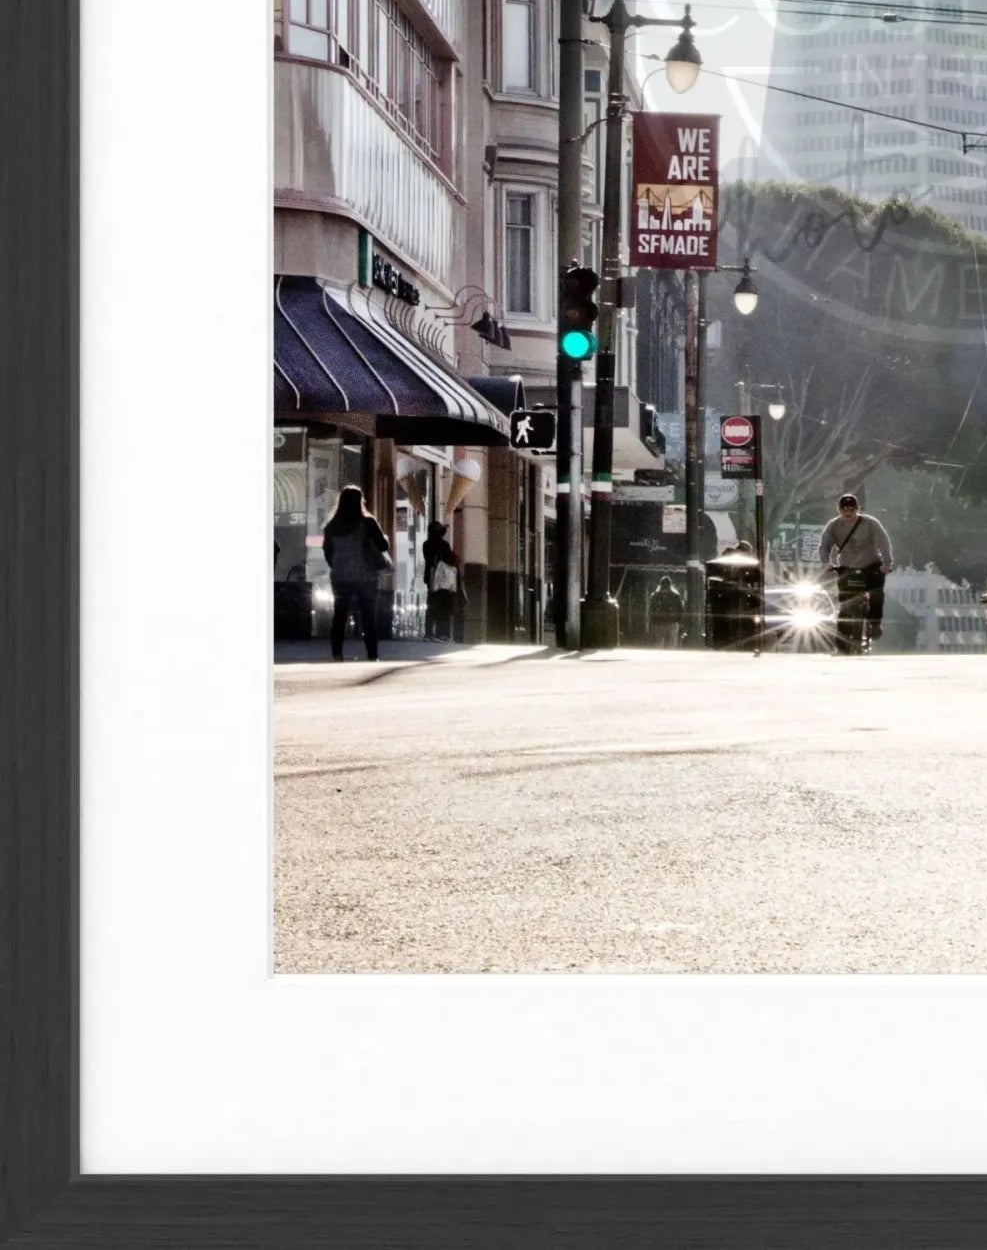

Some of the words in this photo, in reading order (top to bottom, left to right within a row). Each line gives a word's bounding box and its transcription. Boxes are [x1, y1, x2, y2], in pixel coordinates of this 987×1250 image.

[677, 127, 711, 154] WE
[667, 154, 711, 181] ARE
[637, 232, 710, 257] SFMADE
